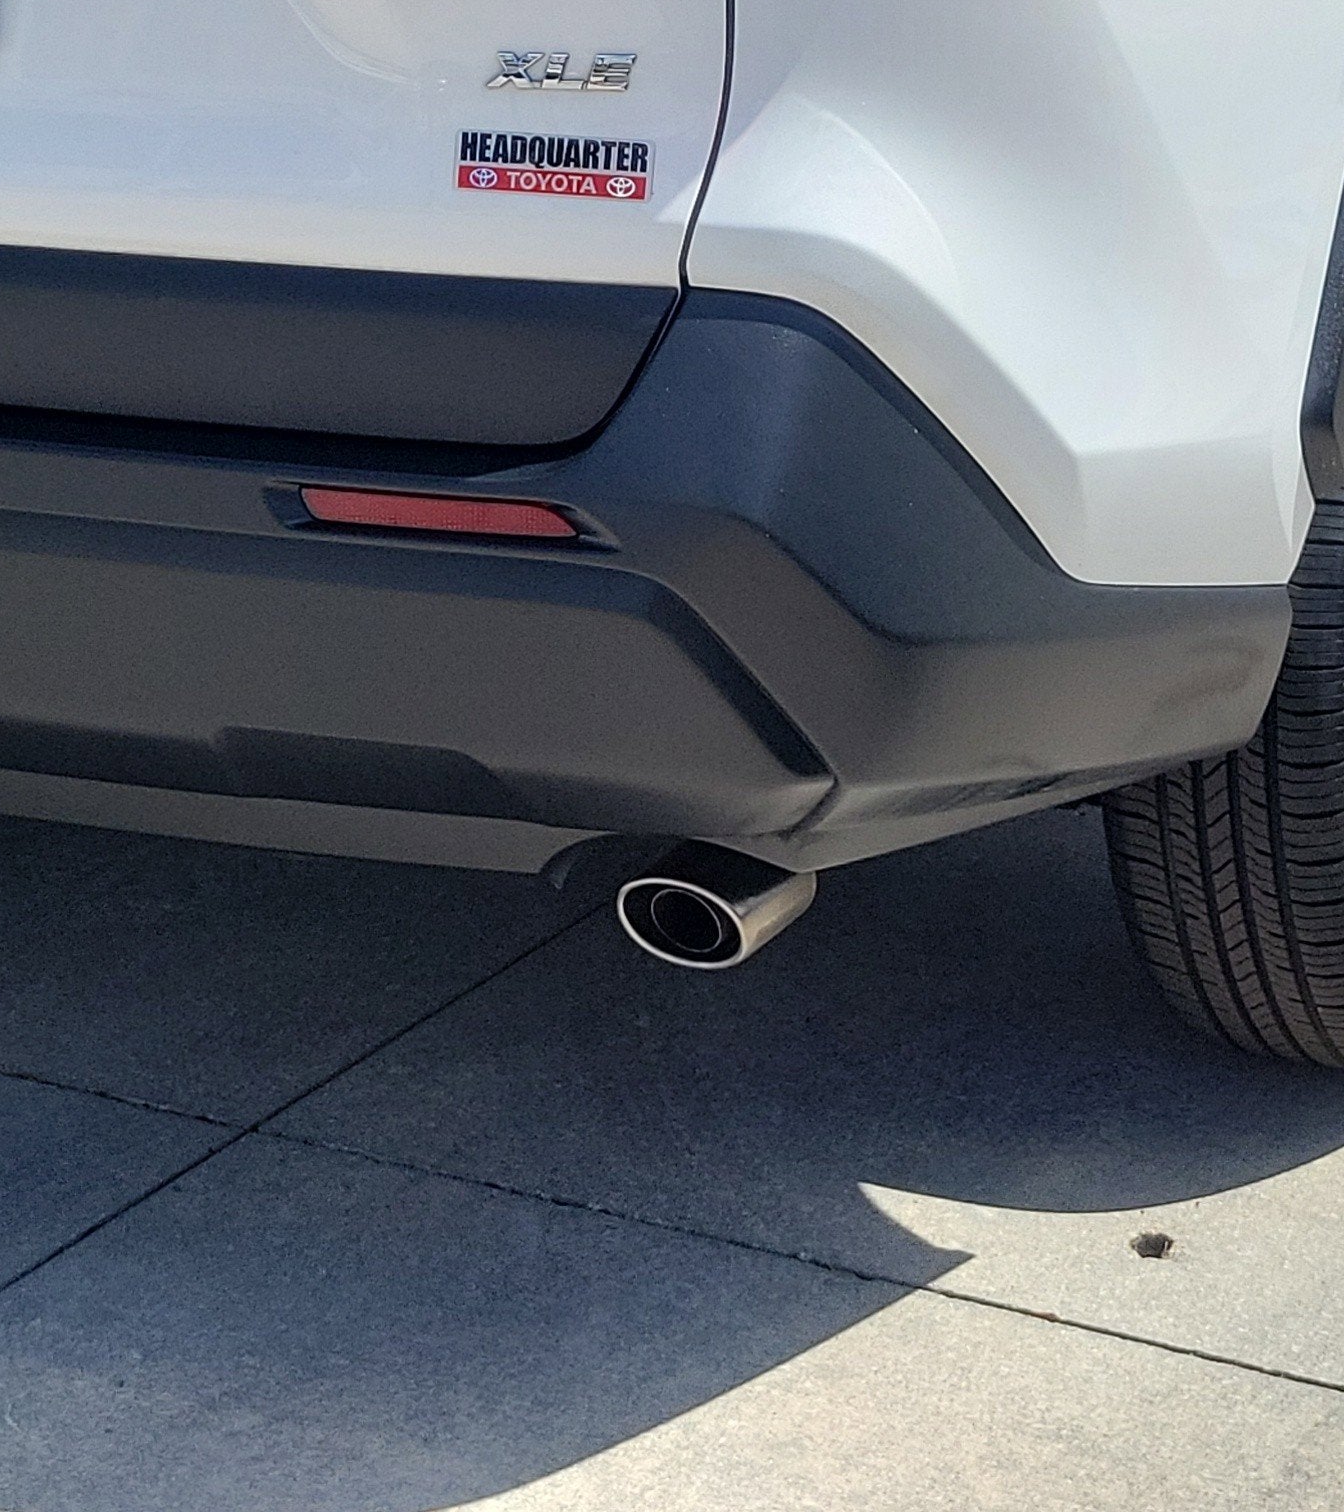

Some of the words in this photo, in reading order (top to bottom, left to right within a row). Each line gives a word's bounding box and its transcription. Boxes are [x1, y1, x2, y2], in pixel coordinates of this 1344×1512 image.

[486, 50, 638, 91] XLE
[460, 131, 648, 173] HEADQUARTER
[506, 172, 597, 194] TOYOTA
